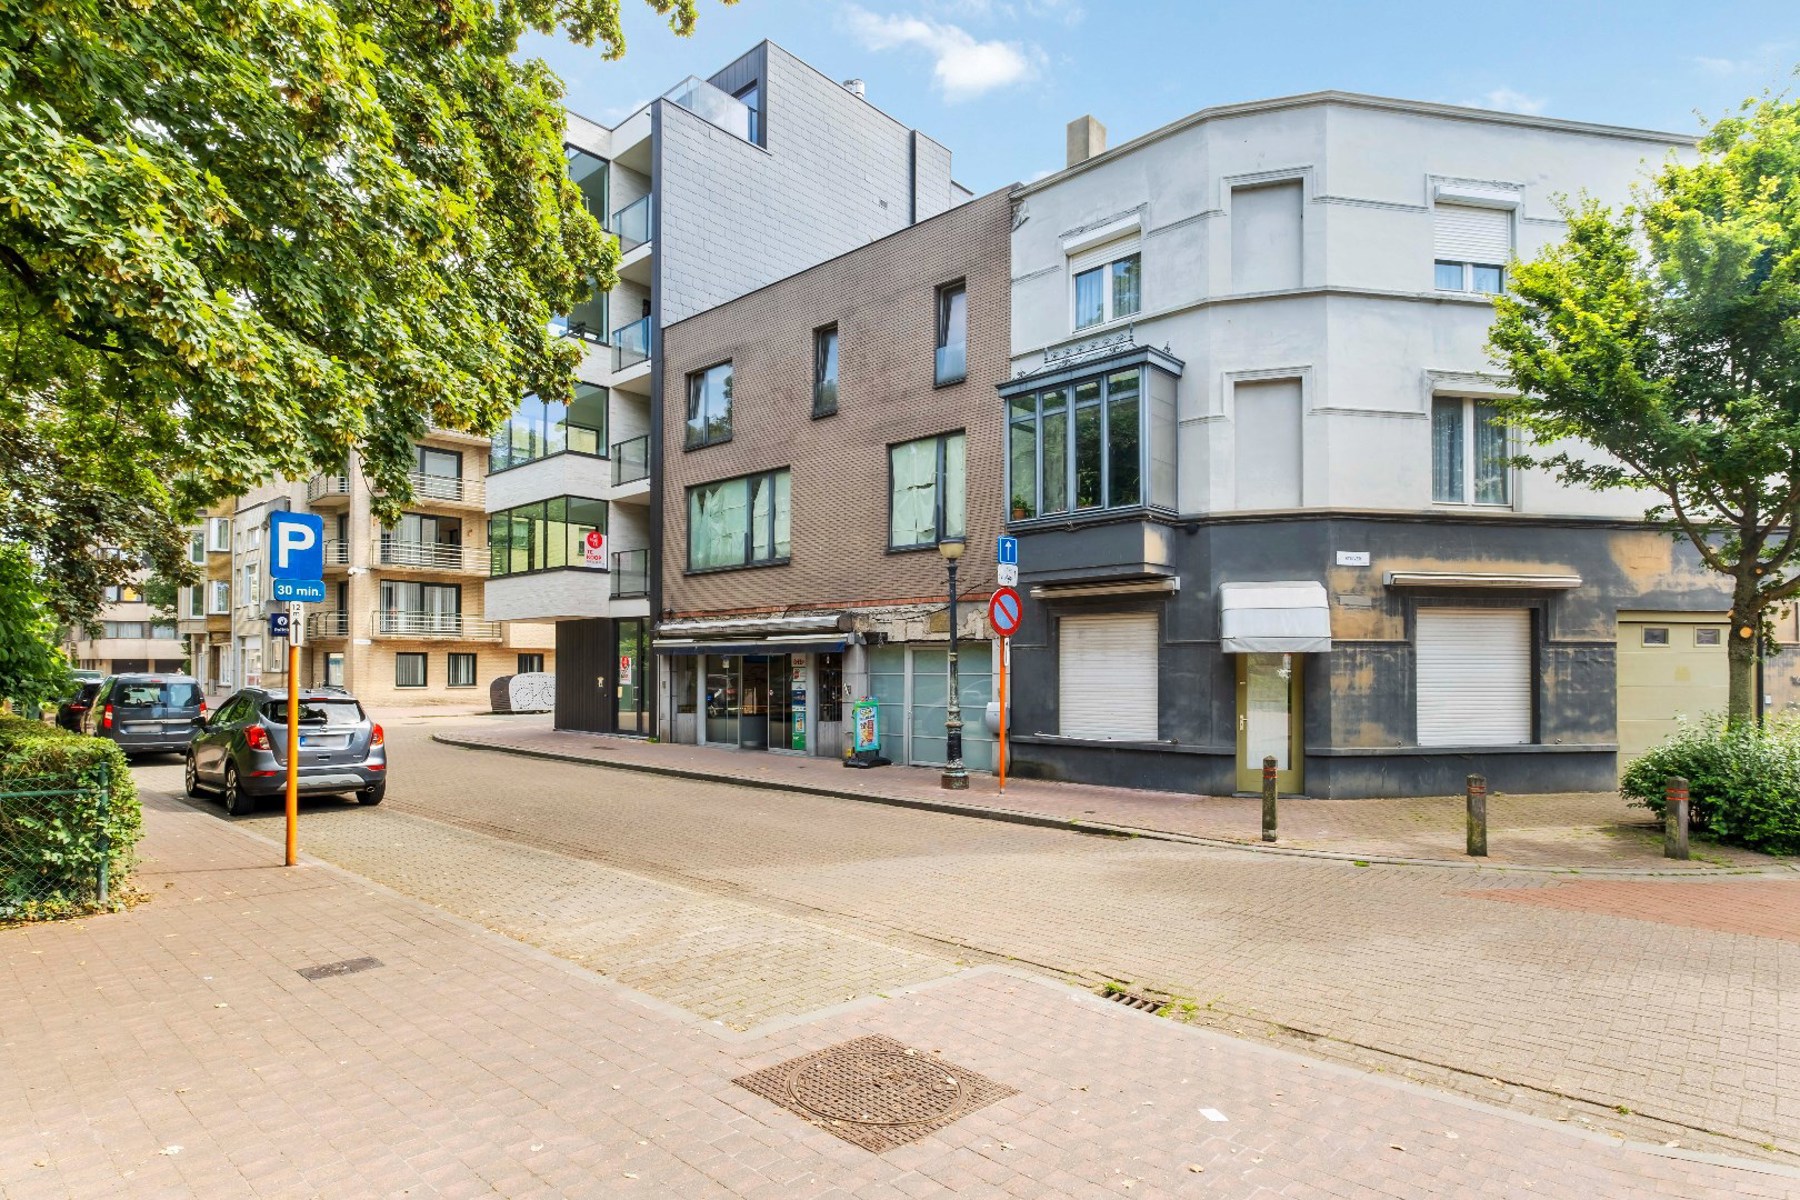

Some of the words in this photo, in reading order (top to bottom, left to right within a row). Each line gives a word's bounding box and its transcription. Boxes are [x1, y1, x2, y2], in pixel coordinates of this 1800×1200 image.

[278, 522, 315, 569] P
[277, 585, 293, 596] 30
[296, 586, 322, 597] min.
